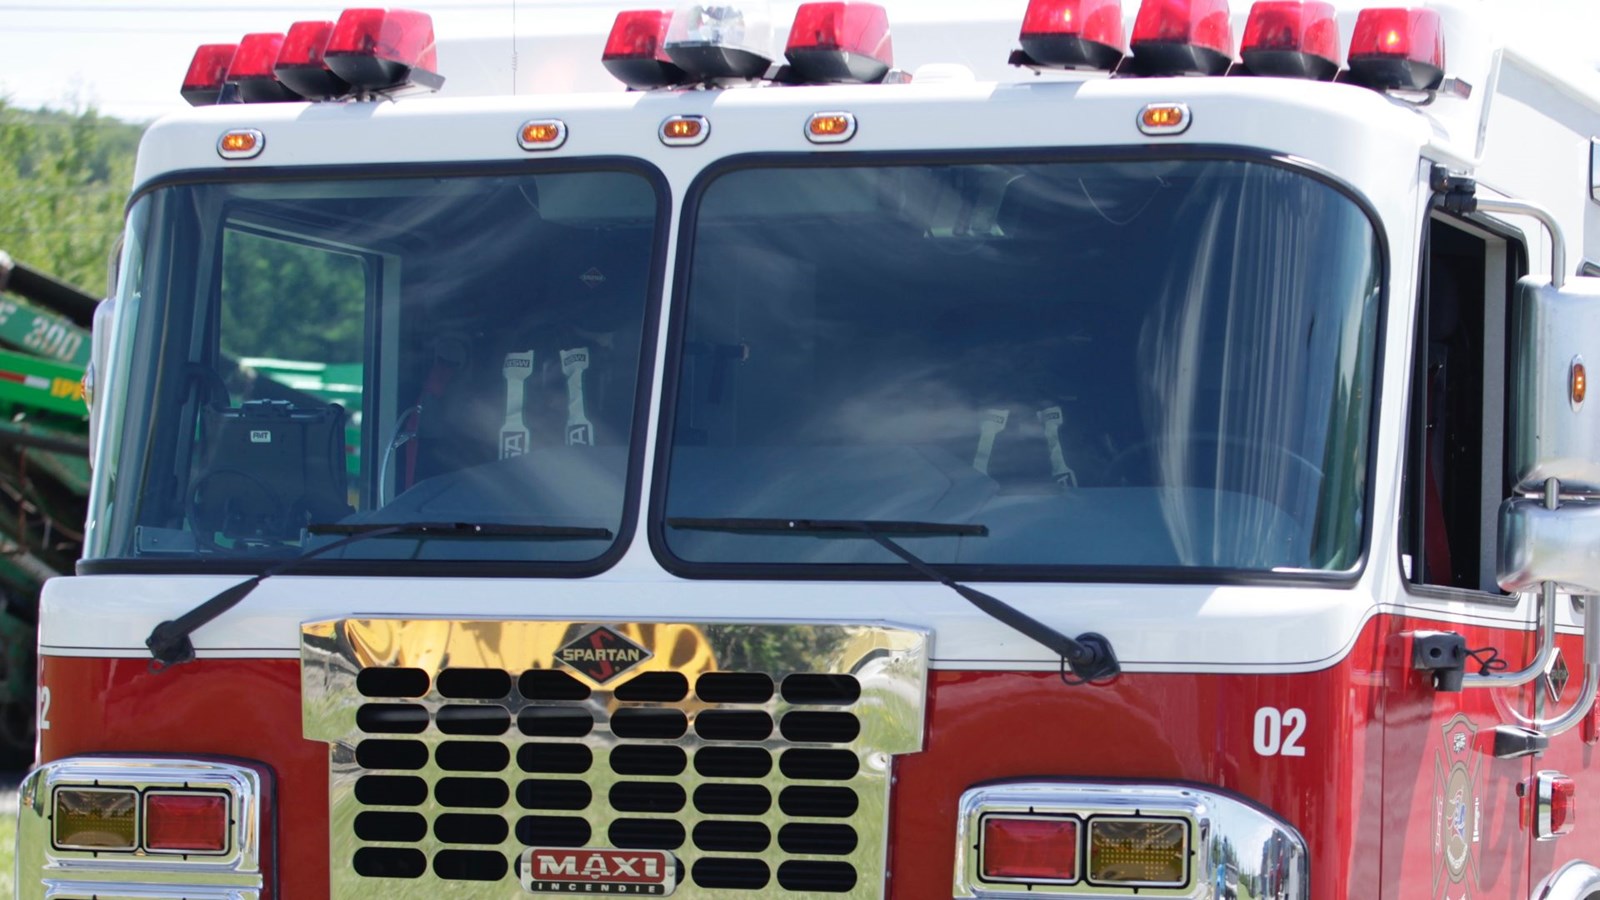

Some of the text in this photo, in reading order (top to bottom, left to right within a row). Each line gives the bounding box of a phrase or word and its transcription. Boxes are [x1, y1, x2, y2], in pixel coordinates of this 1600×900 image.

[562, 648, 640, 662] SPARTAN
[1253, 706, 1307, 757] 02
[538, 882, 656, 894] INCENDIE
